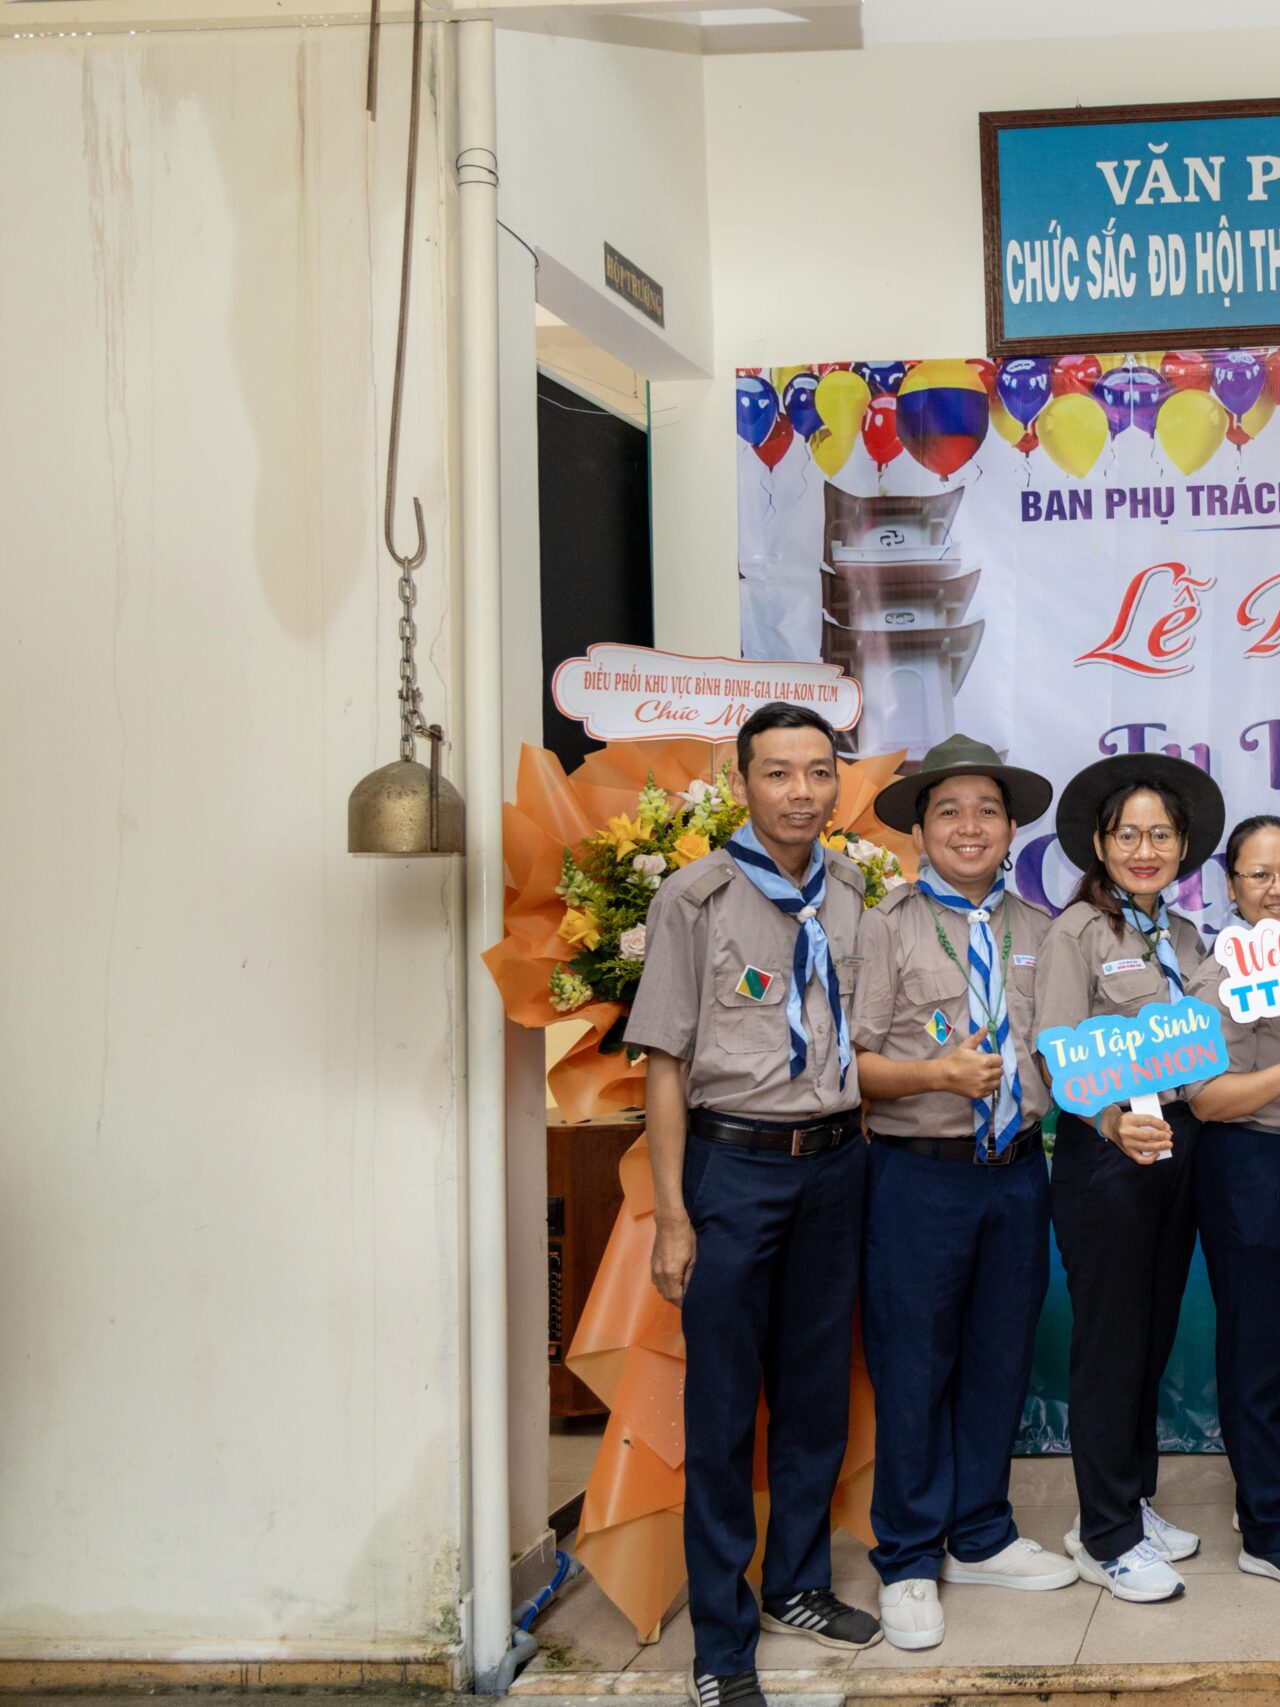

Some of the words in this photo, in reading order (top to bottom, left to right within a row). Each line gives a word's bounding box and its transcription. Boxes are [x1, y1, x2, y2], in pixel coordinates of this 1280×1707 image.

[1096, 141, 1225, 206] VĂN
[1006, 219, 1081, 305] CHỨC
[1086, 216, 1137, 300] SẮC
[1148, 233, 1187, 297] ĐD
[1195, 214, 1245, 308] HỘI
[1021, 488, 1093, 522] BAN
[1105, 486, 1175, 525] PHỤ
[1073, 561, 1214, 676] Lễ
[583, 661, 611, 691] ĐIỀU
[614, 663, 641, 692] PHỐI
[644, 673, 668, 694] KHU
[671, 674, 692, 700] VỰC
[695, 671, 721, 697] BÌNH
[817, 684, 839, 702] TUM
[634, 699, 700, 723] Chúc
[1049, 1037, 1090, 1069] Tu
[1088, 1027, 1145, 1062] Tập
[1148, 1007, 1210, 1044] Sinh
[1064, 1065, 1123, 1106] QUY
[1130, 1039, 1219, 1085] NHƠN
